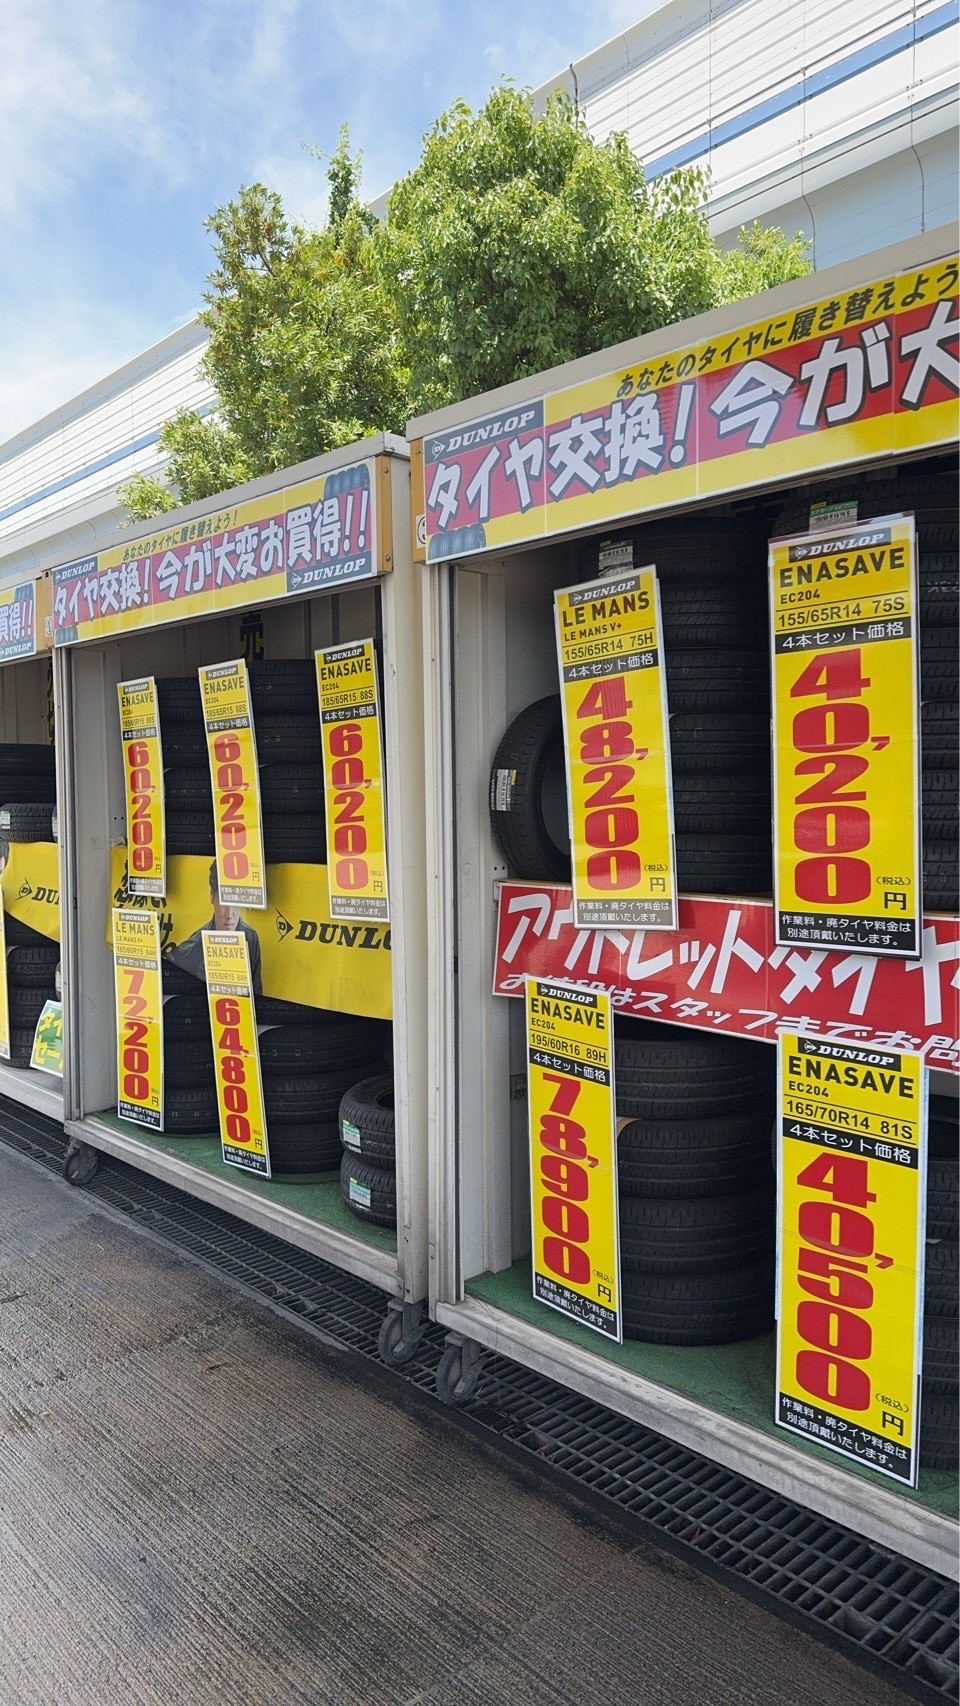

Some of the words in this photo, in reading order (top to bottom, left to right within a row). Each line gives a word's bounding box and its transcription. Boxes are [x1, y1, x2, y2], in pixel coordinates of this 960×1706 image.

[446, 410, 536, 453] DUNLOP
[809, 533, 885, 556] DUNLOP
[61, 561, 95, 580] DUNLOP
[302, 557, 367, 585] DUNLOP
[780, 547, 905, 588] ENASAVE
[583, 581, 635, 601] DUNLOP
[781, 589, 820, 604] EC204
[562, 607, 586, 628] LE
[592, 591, 650, 621] MANS
[779, 602, 862, 627] 155/65R14
[872, 596, 905, 614] 75S
[564, 632, 576, 642] LE
[580, 624, 608, 639] MANS
[610, 622, 622, 632] V+
[783, 621, 904, 649] 4本セット価格
[4, 642, 32, 655] DUNLOP
[332, 648, 362, 661] DUNLOP
[565, 638, 623, 661] 155/65R14
[630, 632, 654, 648] 75H
[212, 667, 236, 678] DUNLOP
[321, 658, 371, 680] ENASAVE
[568, 653, 654, 678] 4本セット価格
[203, 676, 245, 695] ENASAVE
[322, 682, 339, 692] EC204
[121, 692, 154, 707] ENASAVE
[322, 692, 357, 706] 185/65R15
[325, 705, 374, 720] 4本セット価格
[156, 864, 161, 873] 円
[253, 871, 260, 882] 円
[374, 881, 383, 892] 円
[650, 877, 666, 892] 円
[884, 891, 907, 911] 円
[125, 914, 149, 922] DUNLOP
[116, 922, 126, 933] LE
[129, 923, 155, 936] MANS
[207, 946, 244, 959] ENASAVE
[549, 988, 594, 1004] DUNLOP
[531, 997, 605, 1030] ENASAVE
[531, 1018, 556, 1031] EC204
[531, 1033, 580, 1056] 195/60R16
[586, 1048, 607, 1063] 89H
[818, 1045, 895, 1066] DUNLOP
[533, 1052, 606, 1083] 4本セット価格
[789, 1055, 914, 1099] ENASAVE
[789, 1081, 829, 1098] EC204
[152, 1096, 158, 1107] 円
[787, 1100, 870, 1130] 165/70R14
[881, 1120, 913, 1140] 81S
[254, 1138, 262, 1150] 円
[790, 1124, 911, 1164] 4本セット価格
[597, 1283, 612, 1303] 円
[882, 1411, 905, 1437] 円
